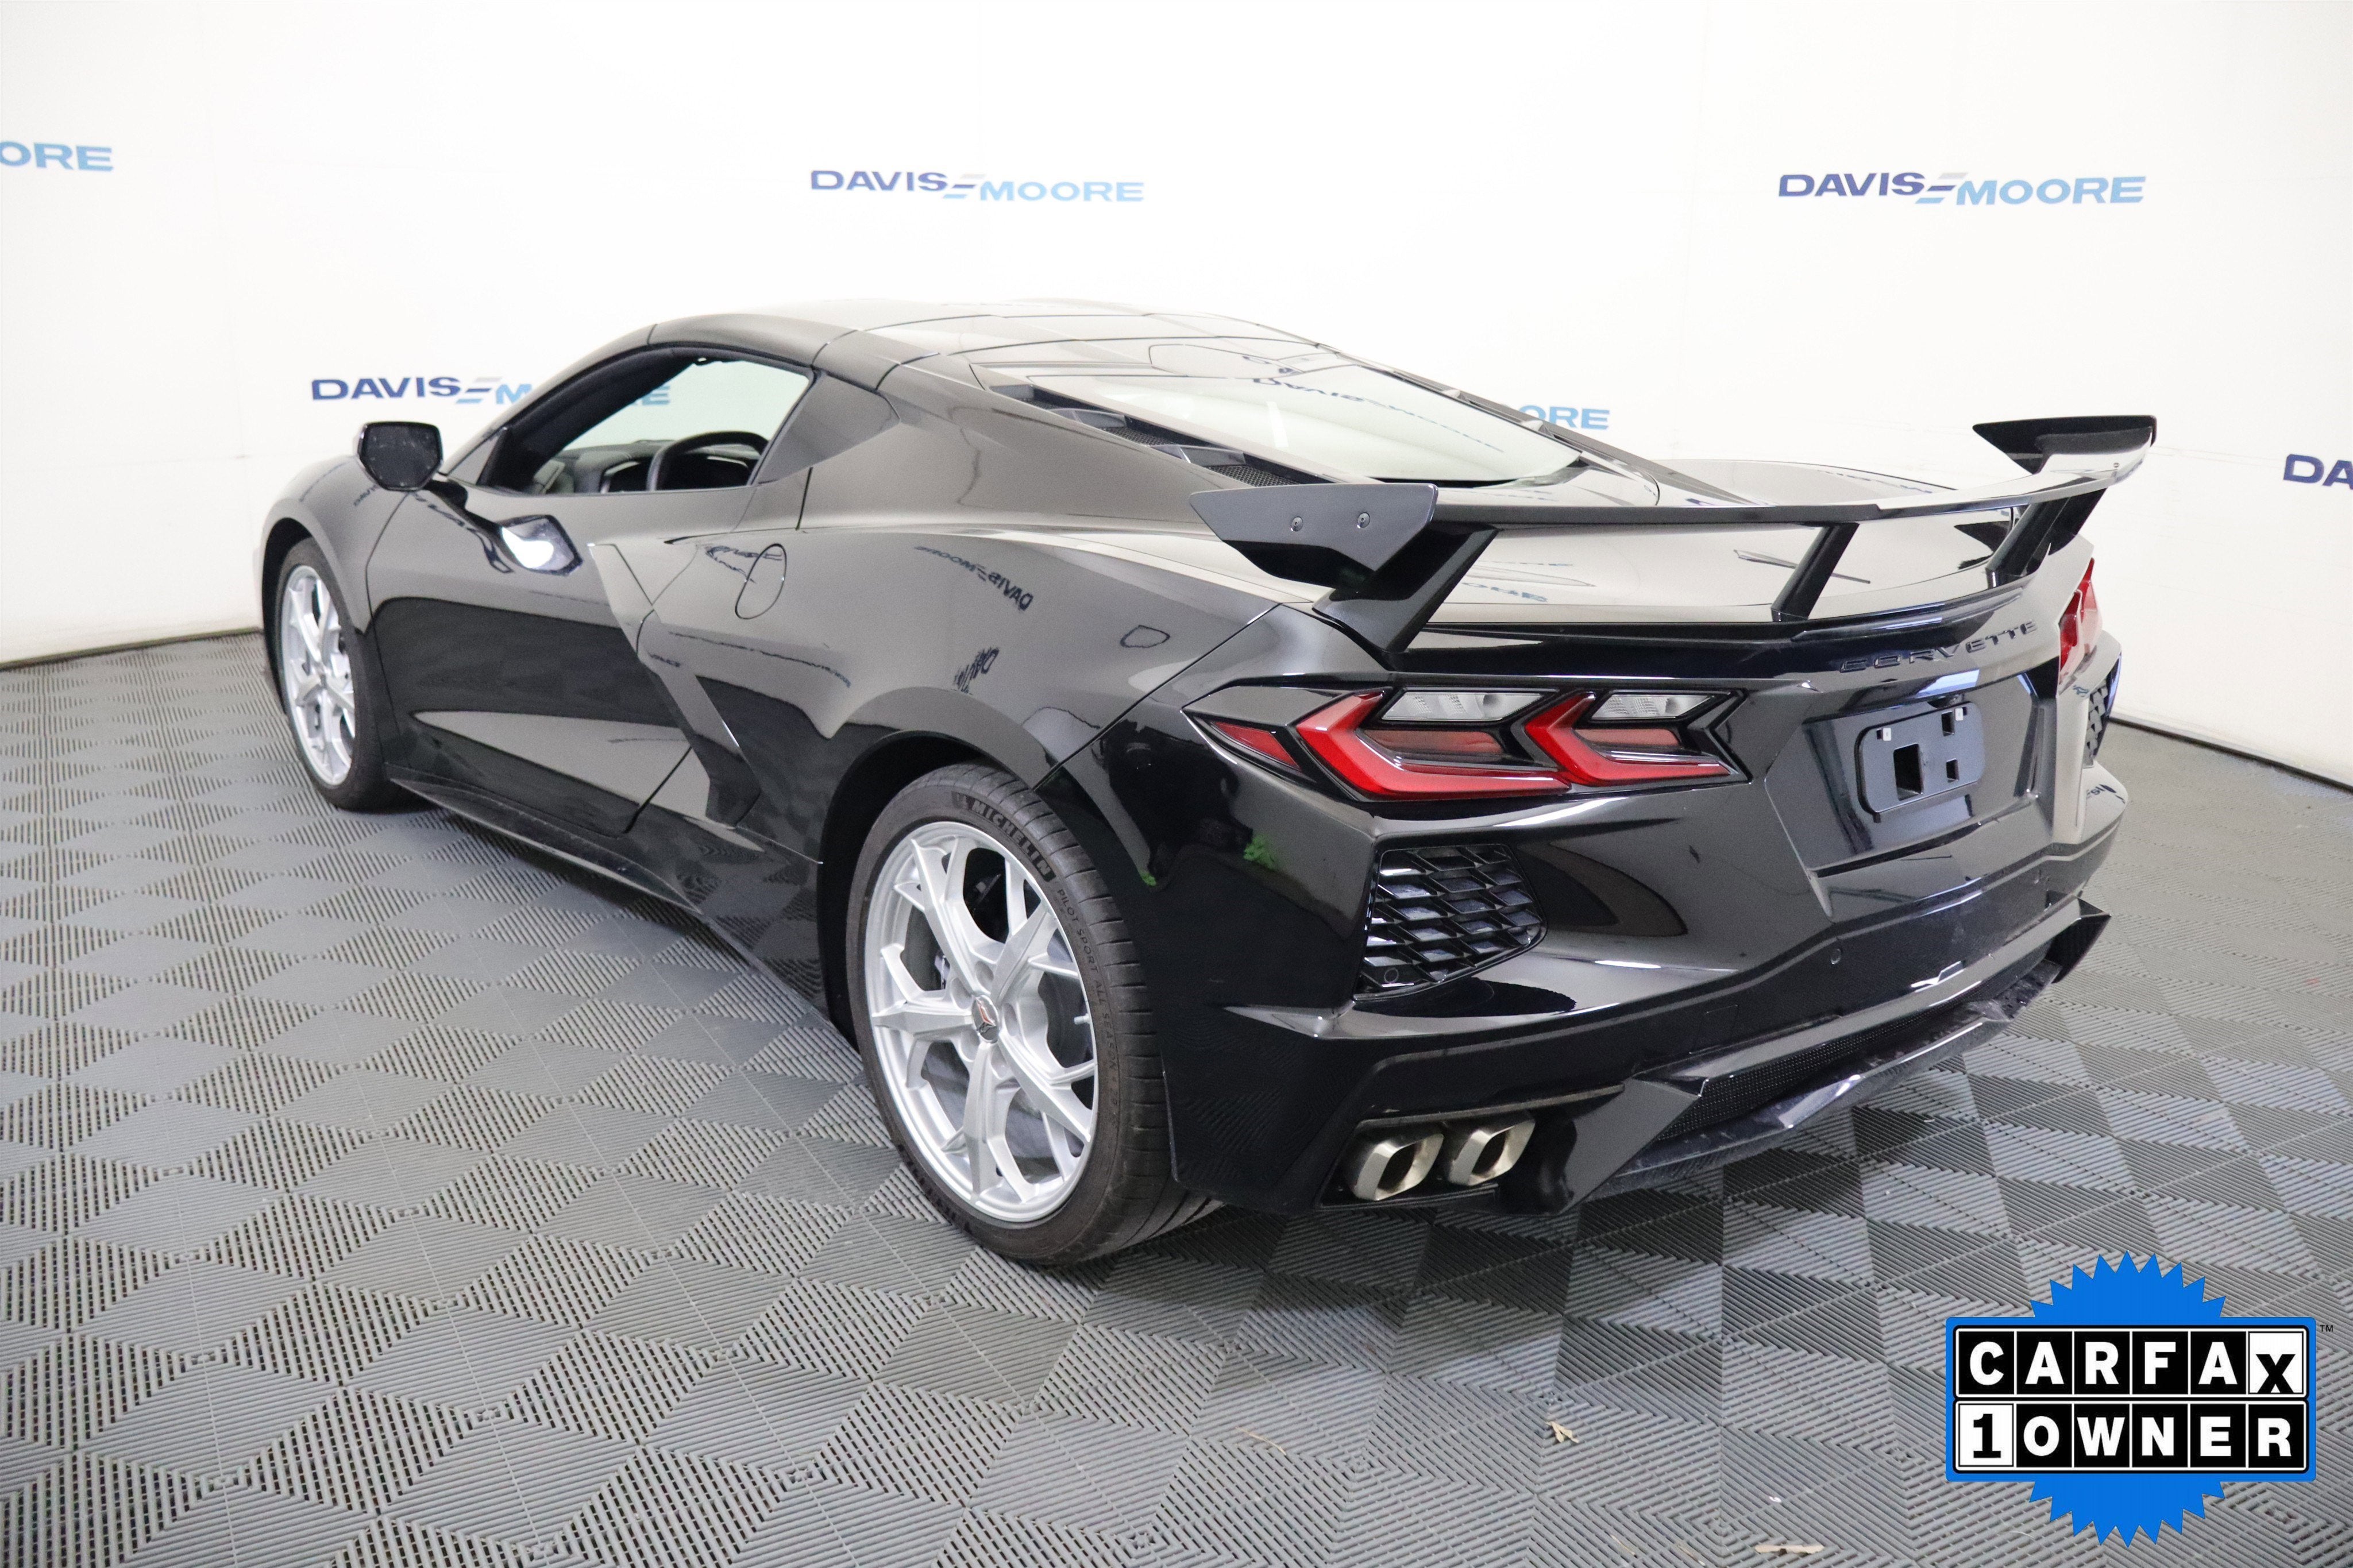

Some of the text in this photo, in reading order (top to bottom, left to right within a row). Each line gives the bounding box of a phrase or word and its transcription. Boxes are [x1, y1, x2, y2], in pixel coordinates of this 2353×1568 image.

[811, 170, 1144, 202] DAVIS MOORE
[1779, 172, 2146, 206] DAVIS MOORE
[311, 376, 460, 401] DAVIS
[1839, 619, 2038, 673] CORVETTE
[970, 796, 1052, 876] MICHELIN
[1056, 889, 1079, 922] PILOT
[1077, 928, 1100, 974] SPORT
[1094, 979, 1109, 1004] ALL
[1102, 1012, 1117, 1070] SEASON
